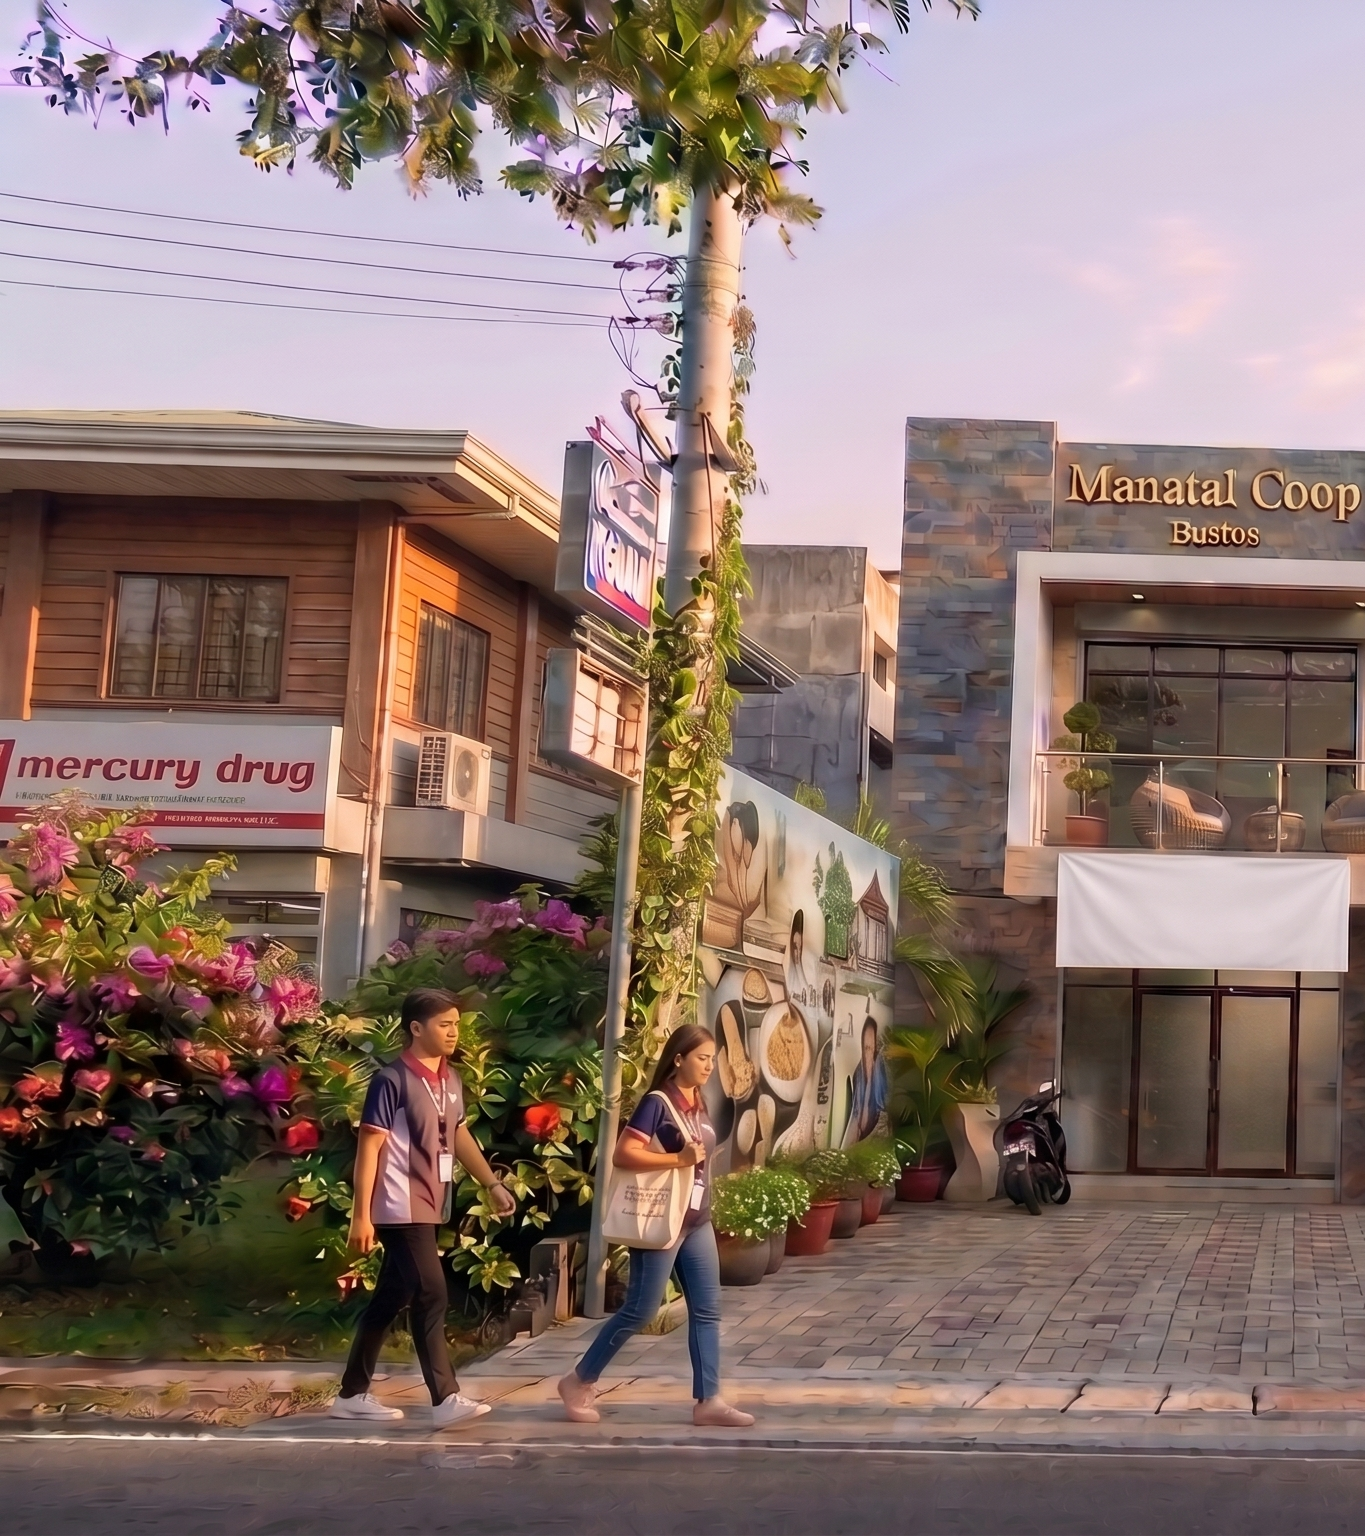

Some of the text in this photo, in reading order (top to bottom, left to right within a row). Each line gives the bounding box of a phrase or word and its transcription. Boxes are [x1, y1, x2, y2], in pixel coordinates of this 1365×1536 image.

[1065, 463, 1362, 523] Manatal Coop
[1169, 520, 1260, 546] Bustos
[17, 753, 316, 793] mercury drug
